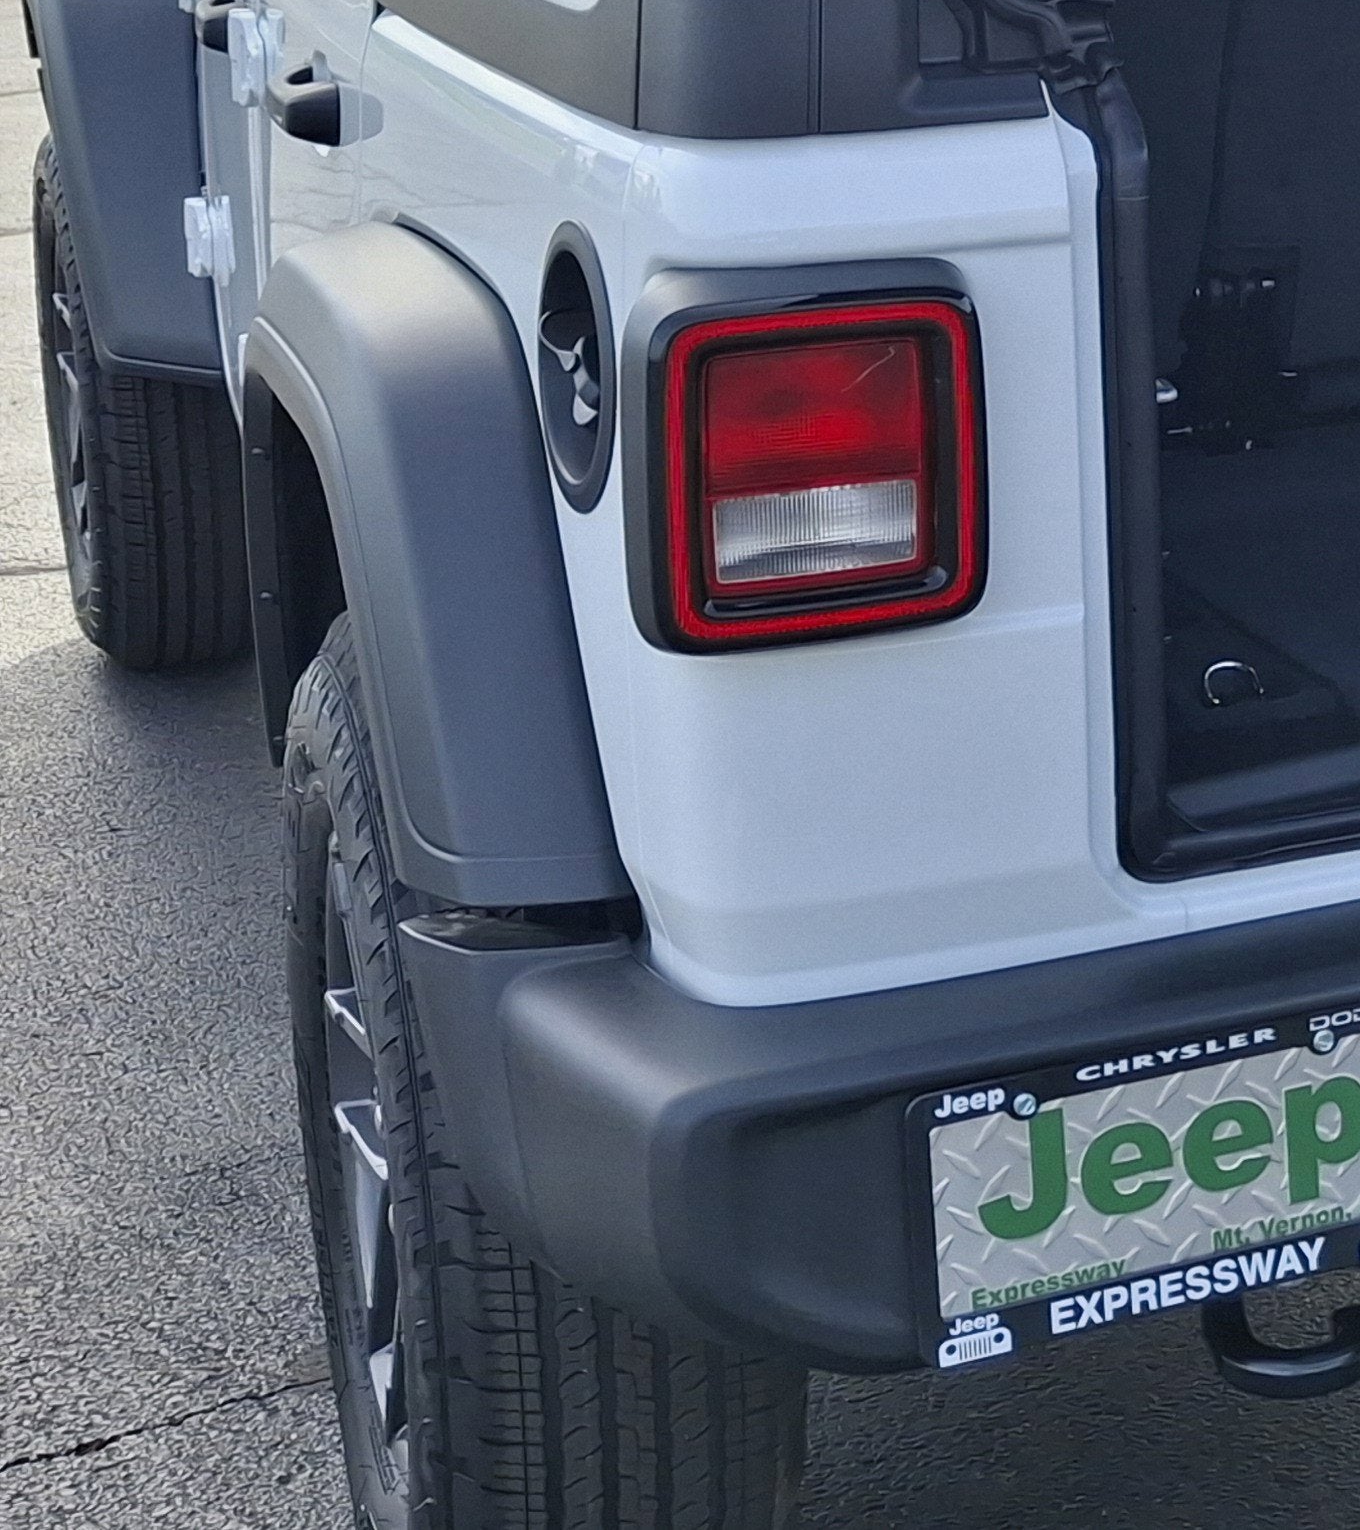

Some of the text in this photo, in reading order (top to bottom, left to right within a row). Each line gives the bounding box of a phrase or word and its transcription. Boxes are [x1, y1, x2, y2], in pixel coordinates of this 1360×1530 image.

[1075, 1027, 1278, 1082] CHRYSLER
[934, 1087, 1006, 1118] Jeep
[971, 1258, 1127, 1310] Expressway
[1050, 1236, 1326, 1335] EXPRESSWAY
[949, 1313, 1000, 1336] Jeep
